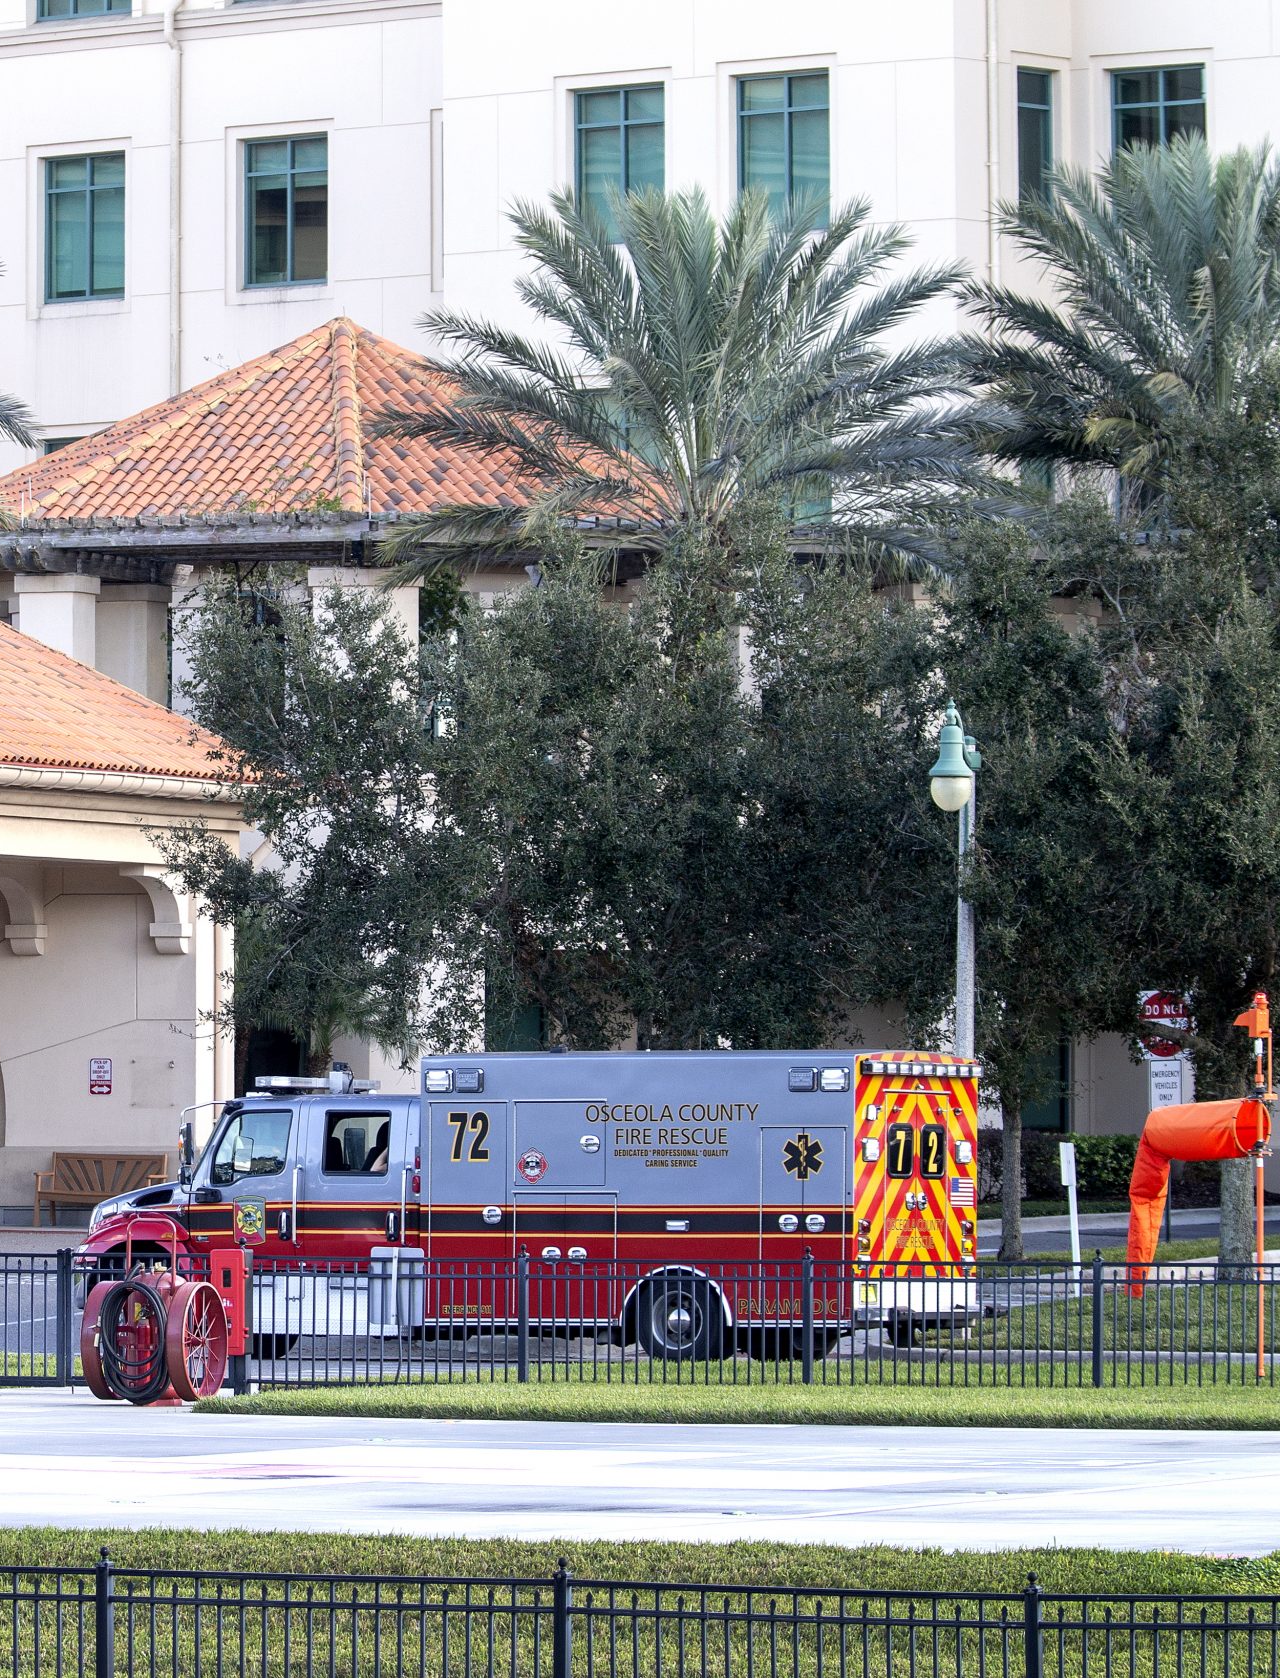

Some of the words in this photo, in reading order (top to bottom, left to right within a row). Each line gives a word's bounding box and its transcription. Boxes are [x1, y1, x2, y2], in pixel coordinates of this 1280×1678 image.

[1145, 1004, 1159, 1015] DO
[1151, 1070, 1180, 1078] EMERGENCY
[1154, 1082, 1178, 1090] VEHICLES
[1159, 1093, 1174, 1101] ONLY
[585, 1103, 674, 1123] OSCEOLA
[678, 1103, 759, 1122] COUNTY
[448, 1111, 489, 1162] 72
[615, 1128, 652, 1145] FIRE
[658, 1128, 728, 1145] RESCUE
[614, 1149, 649, 1157] DEDICATED
[652, 1149, 700, 1157] PROFESSIONAL
[702, 1149, 729, 1158] QUALITY
[645, 1159, 669, 1168] CARING
[670, 1159, 698, 1168] SERVICE
[886, 1217, 917, 1232] OSCEOLA
[917, 1218, 946, 1232] COUNTY
[910, 1235, 936, 1250] RESCUE
[442, 1305, 479, 1314] EMERGNCY
[481, 1305, 492, 1314] 911
[737, 1298, 839, 1316] PARAMDC
